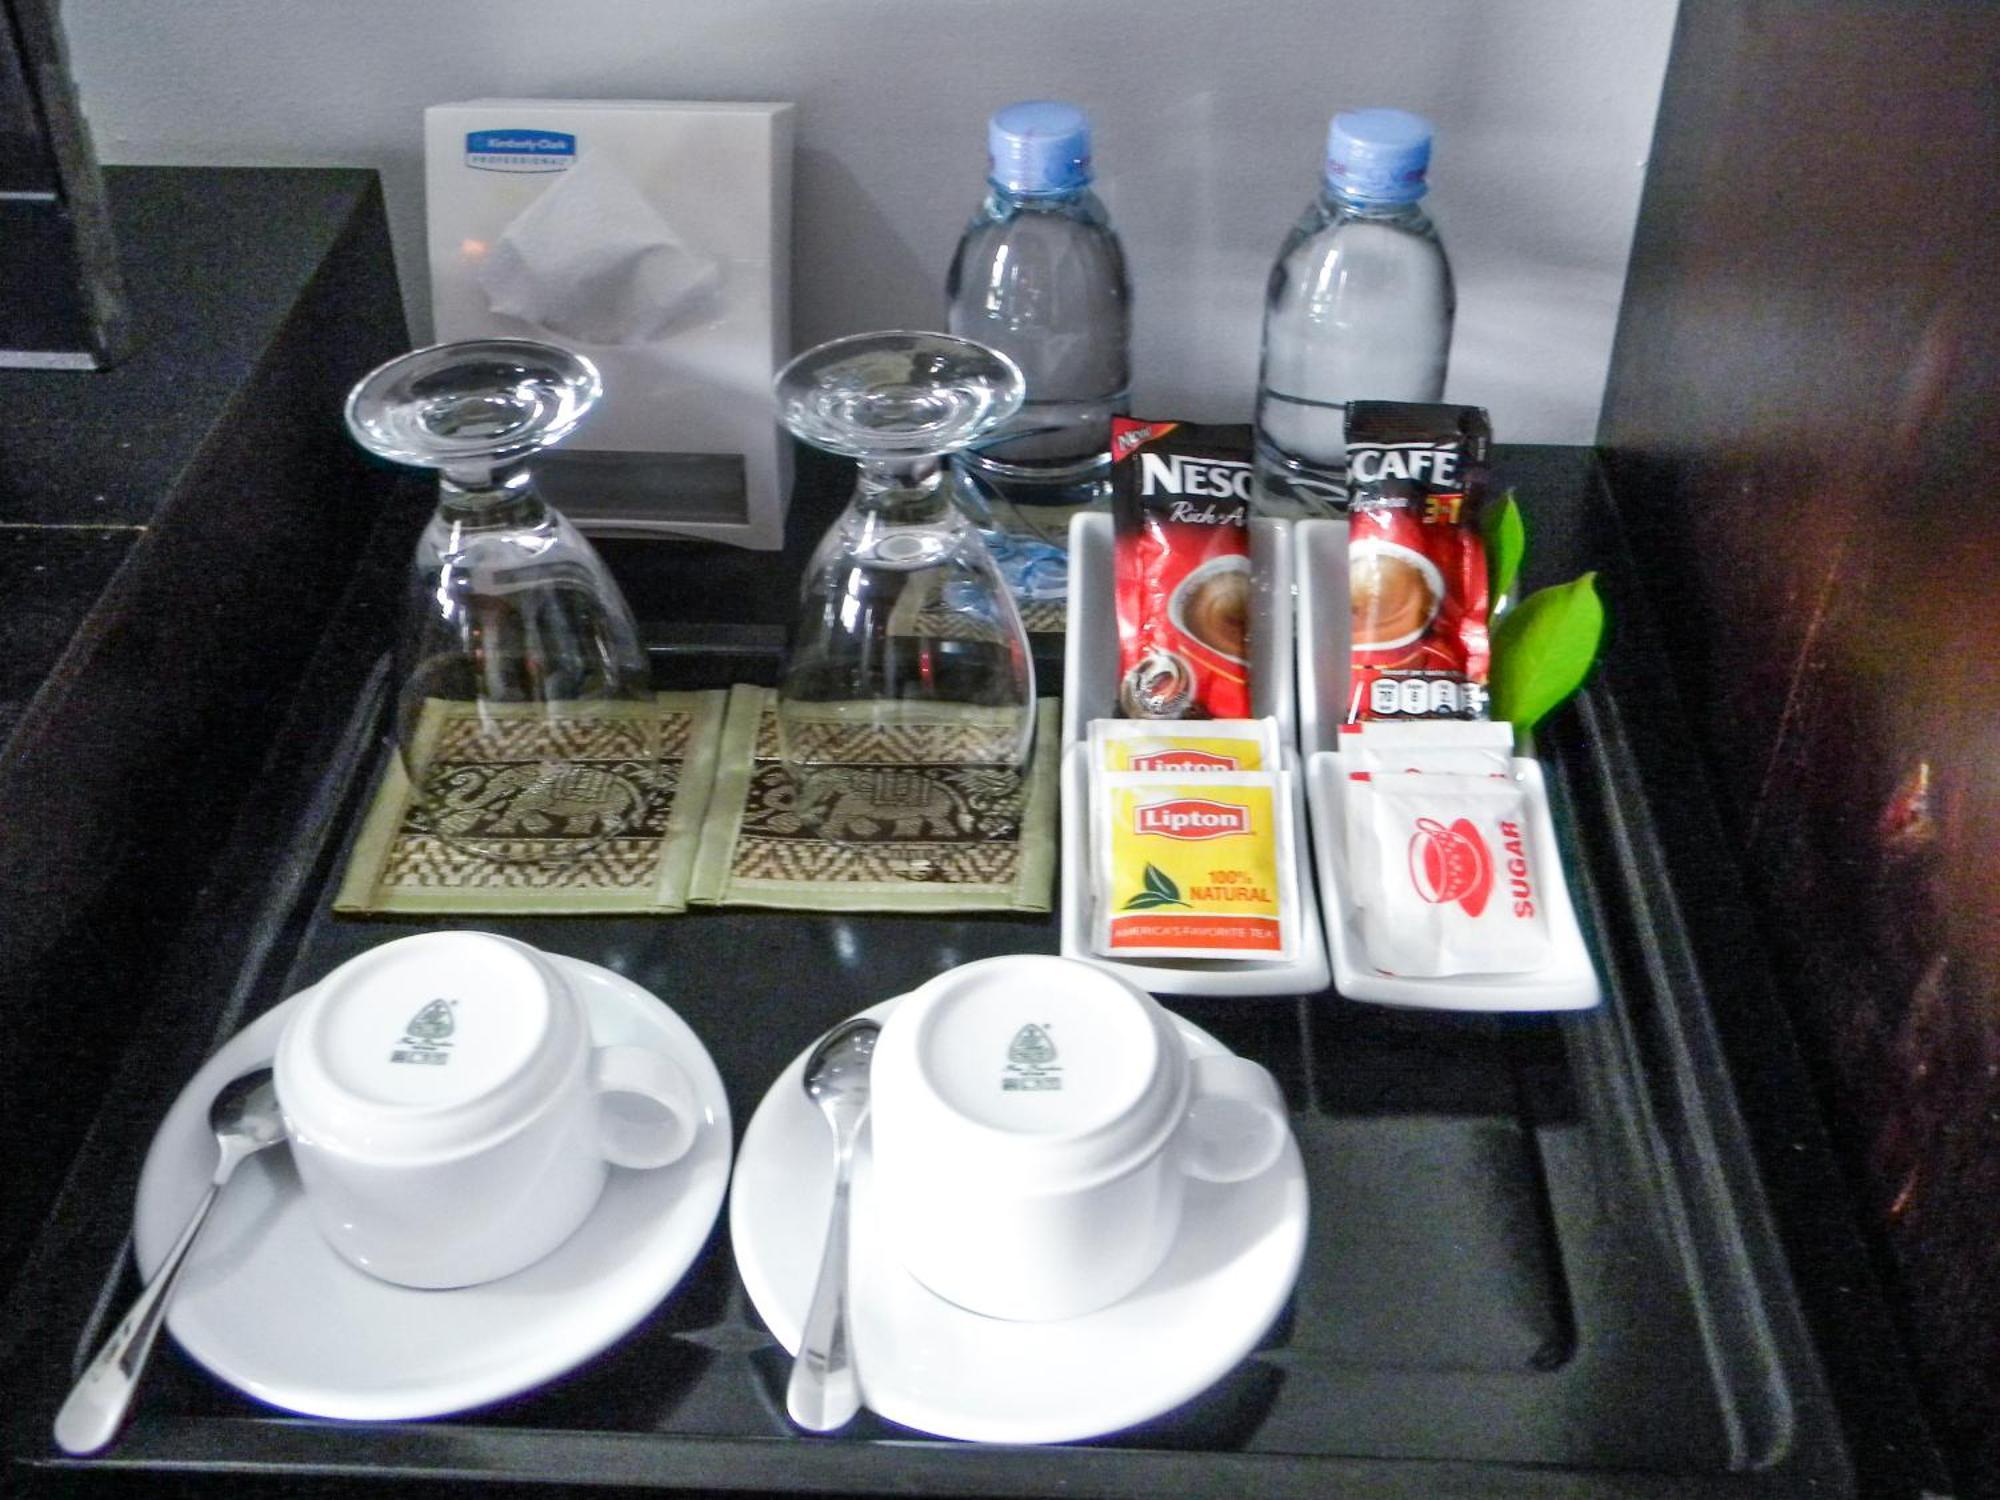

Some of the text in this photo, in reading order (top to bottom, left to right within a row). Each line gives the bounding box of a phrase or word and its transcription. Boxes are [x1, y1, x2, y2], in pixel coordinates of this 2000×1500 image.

[1145, 810, 1239, 831] Lipton
[1208, 870, 1252, 884] 100%
[1501, 820, 1534, 918] SUGAR
[1189, 886, 1272, 903] NATURAL
[1250, 928, 1273, 938] TEA
